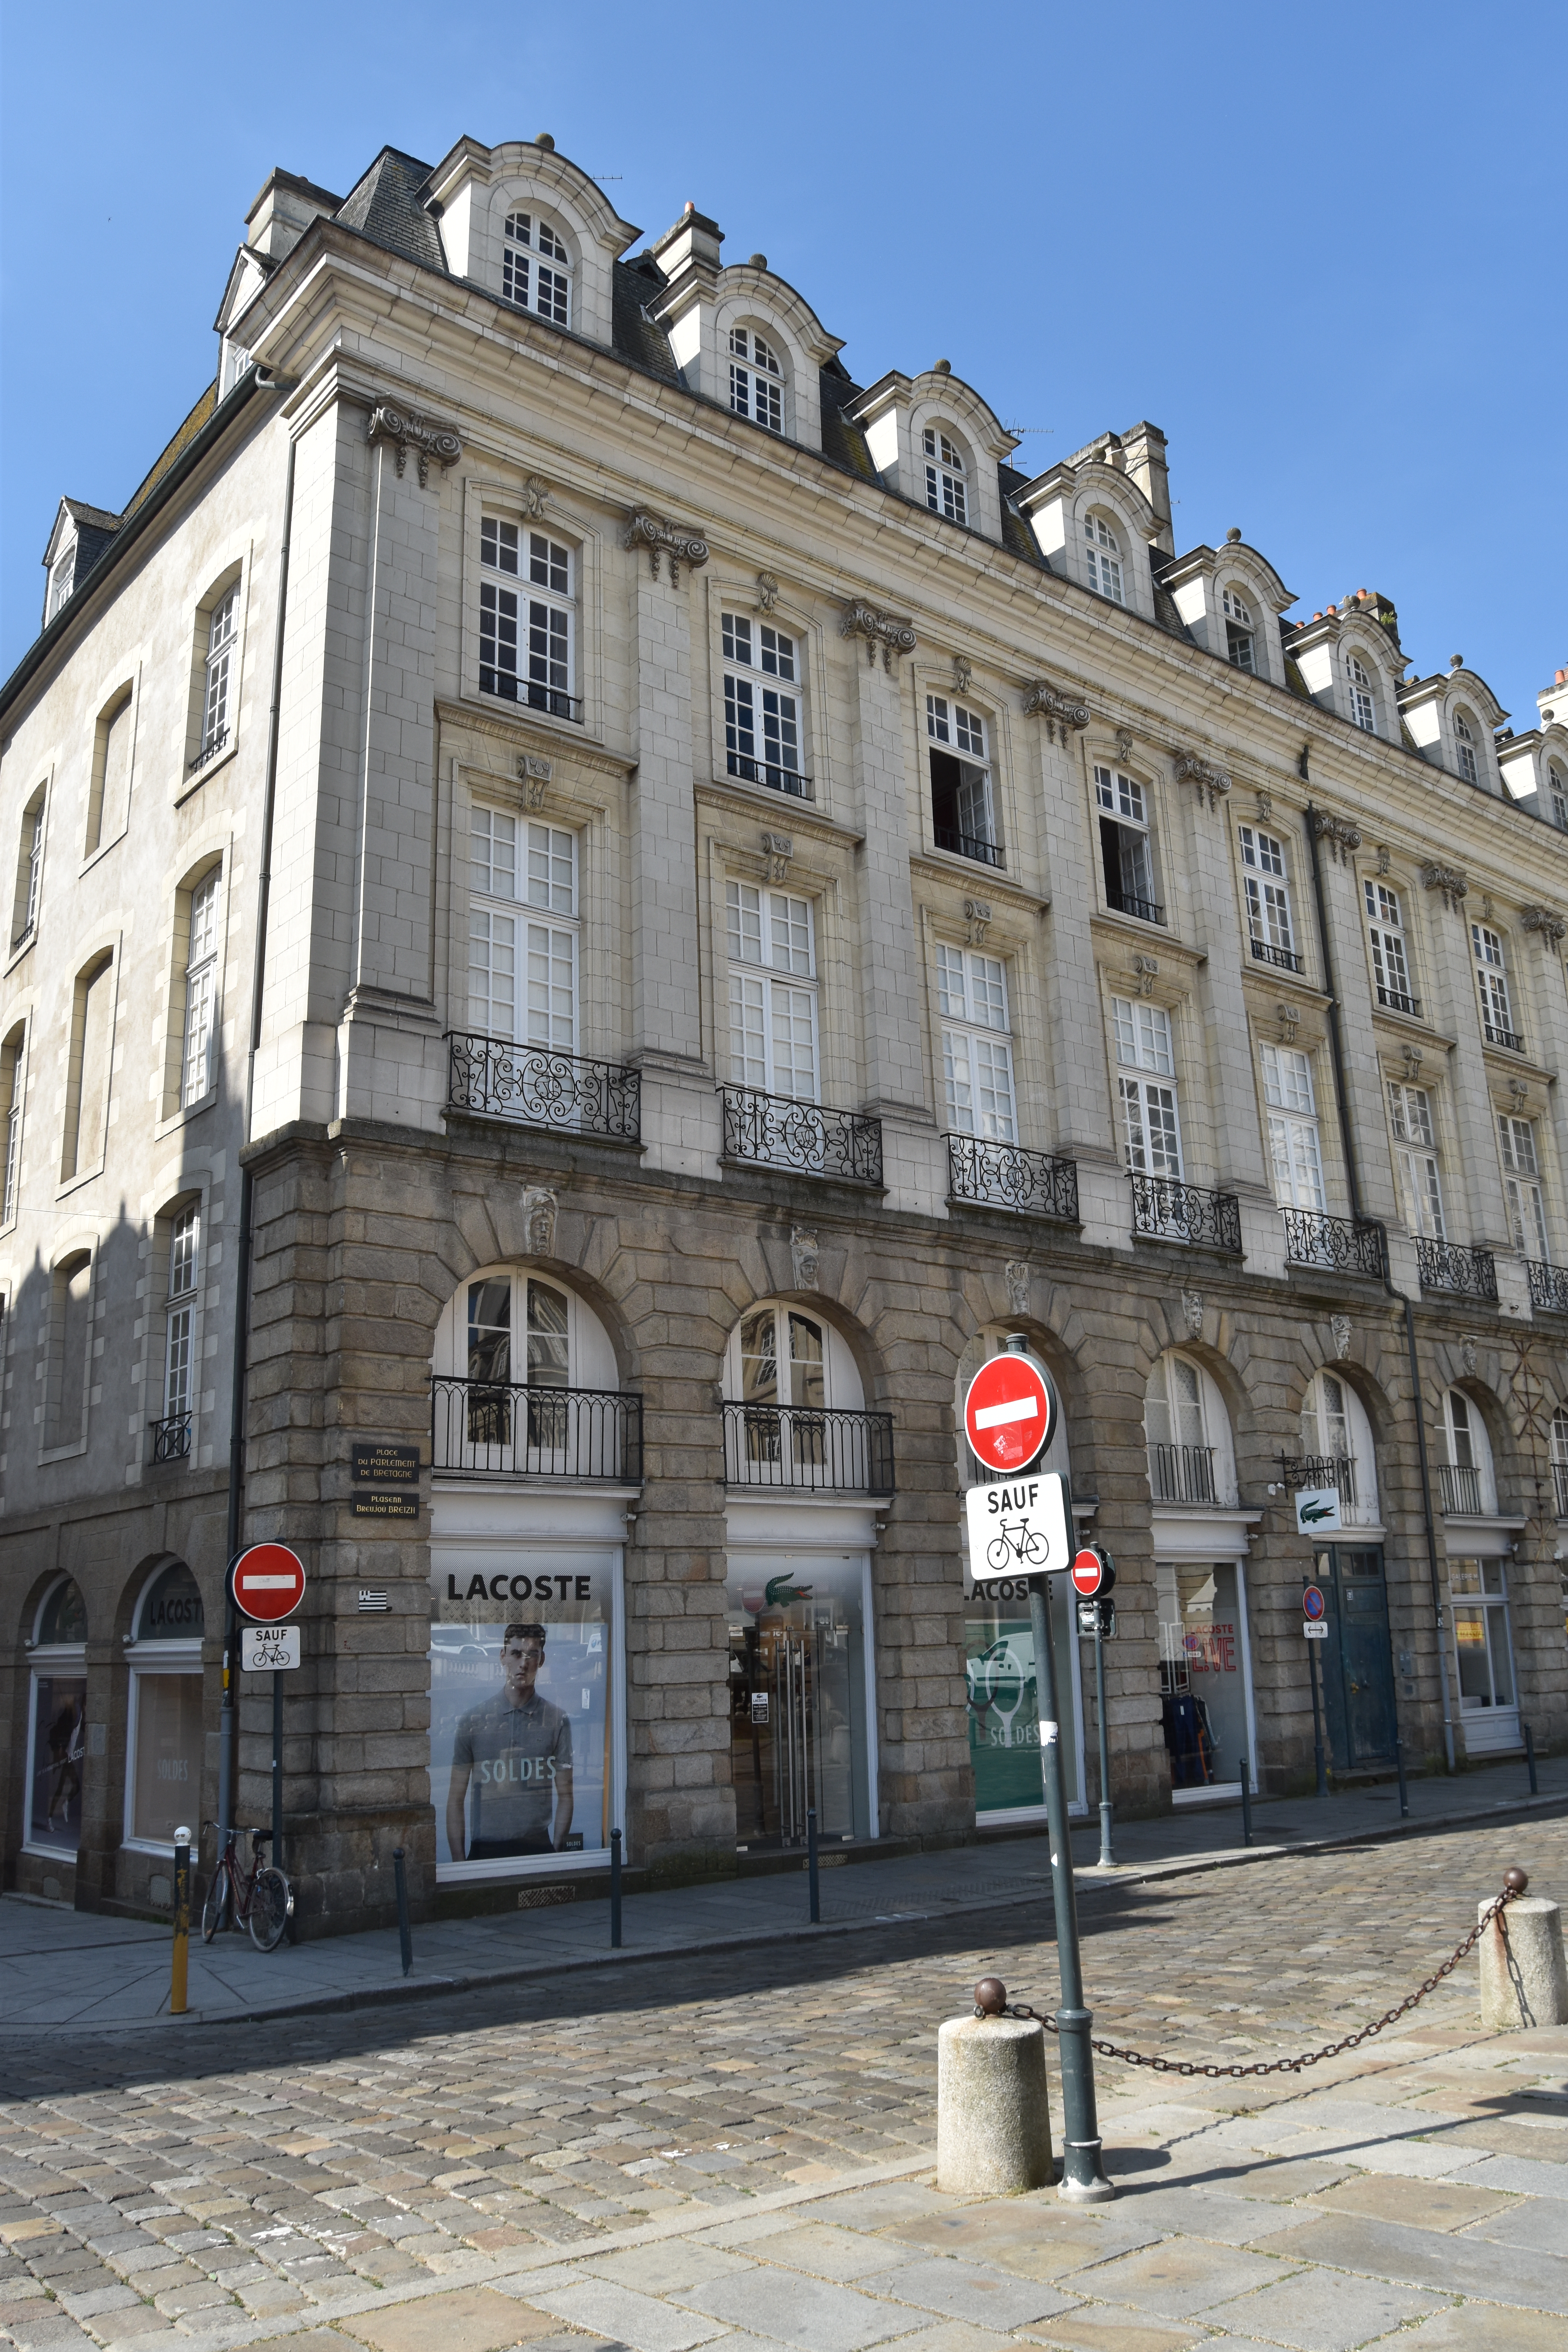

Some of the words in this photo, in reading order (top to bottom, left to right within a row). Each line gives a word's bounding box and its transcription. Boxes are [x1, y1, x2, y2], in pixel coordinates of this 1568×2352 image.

[988, 1483, 1038, 1514] SAUF
[448, 1574, 590, 1601] LACOSTE
[256, 1629, 287, 1641] SAUF
[1190, 1624, 1234, 1634] LACOSTE
[157, 1759, 188, 1781] SOLDES
[481, 1756, 556, 1784] SOLDES
